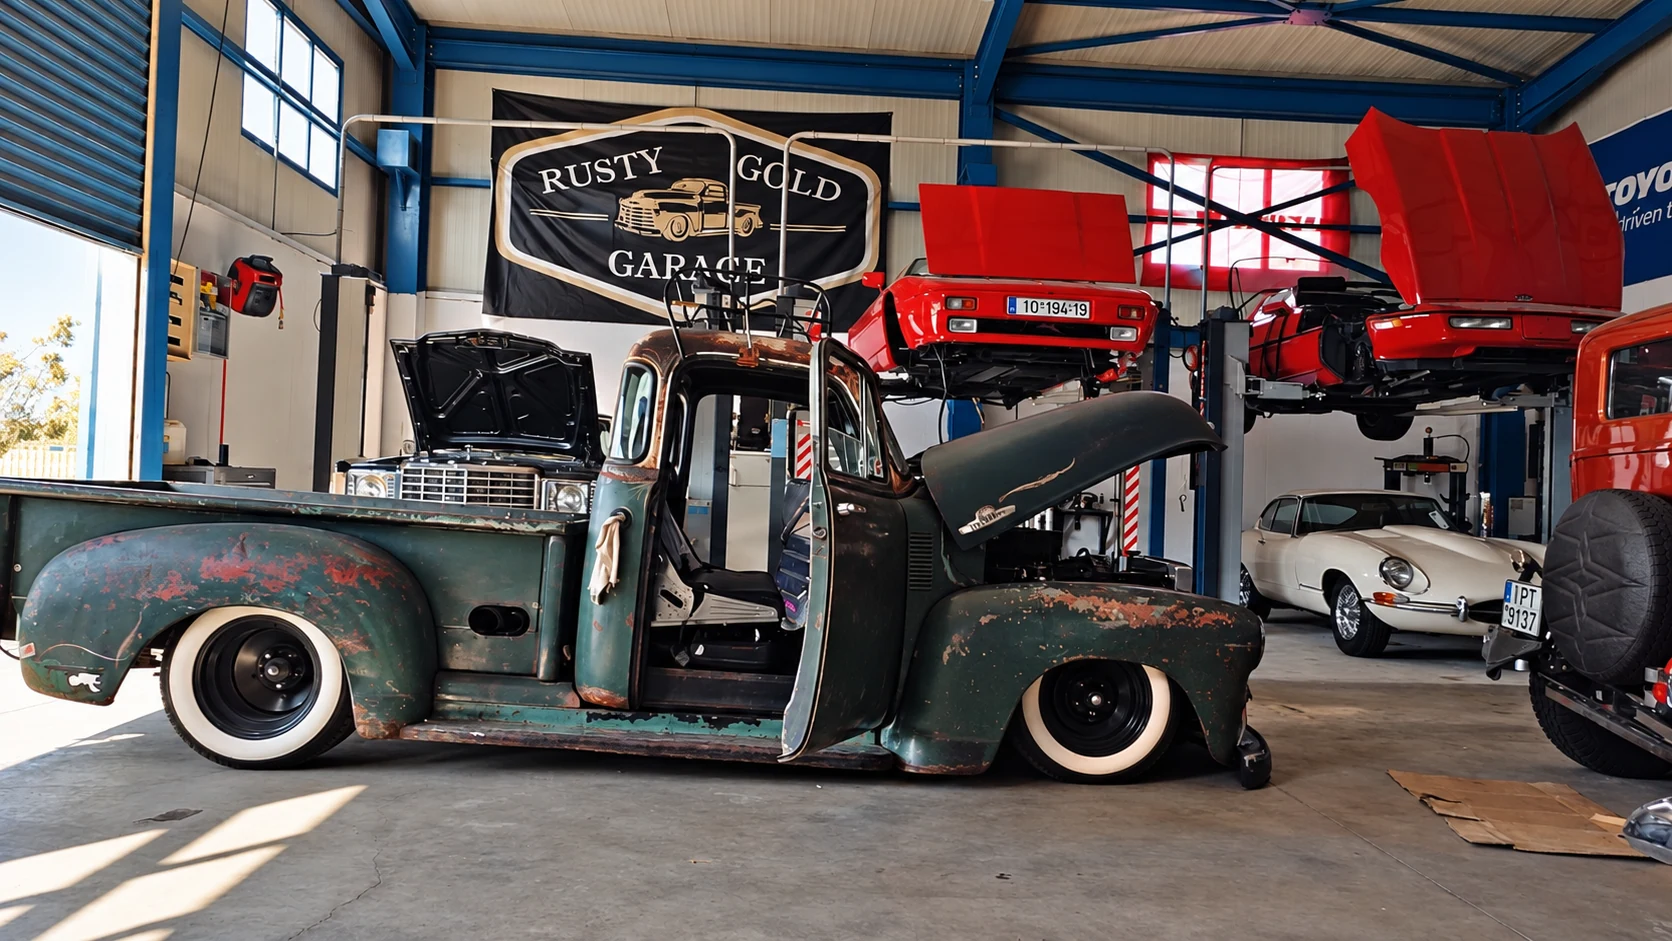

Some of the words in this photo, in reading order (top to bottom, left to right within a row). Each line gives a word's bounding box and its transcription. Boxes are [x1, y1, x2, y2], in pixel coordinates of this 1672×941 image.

[538, 146, 663, 195] RUSTY
[736, 154, 842, 202] GOLD
[607, 249, 766, 285] GARAGE
[1507, 607, 1537, 631] 9137
